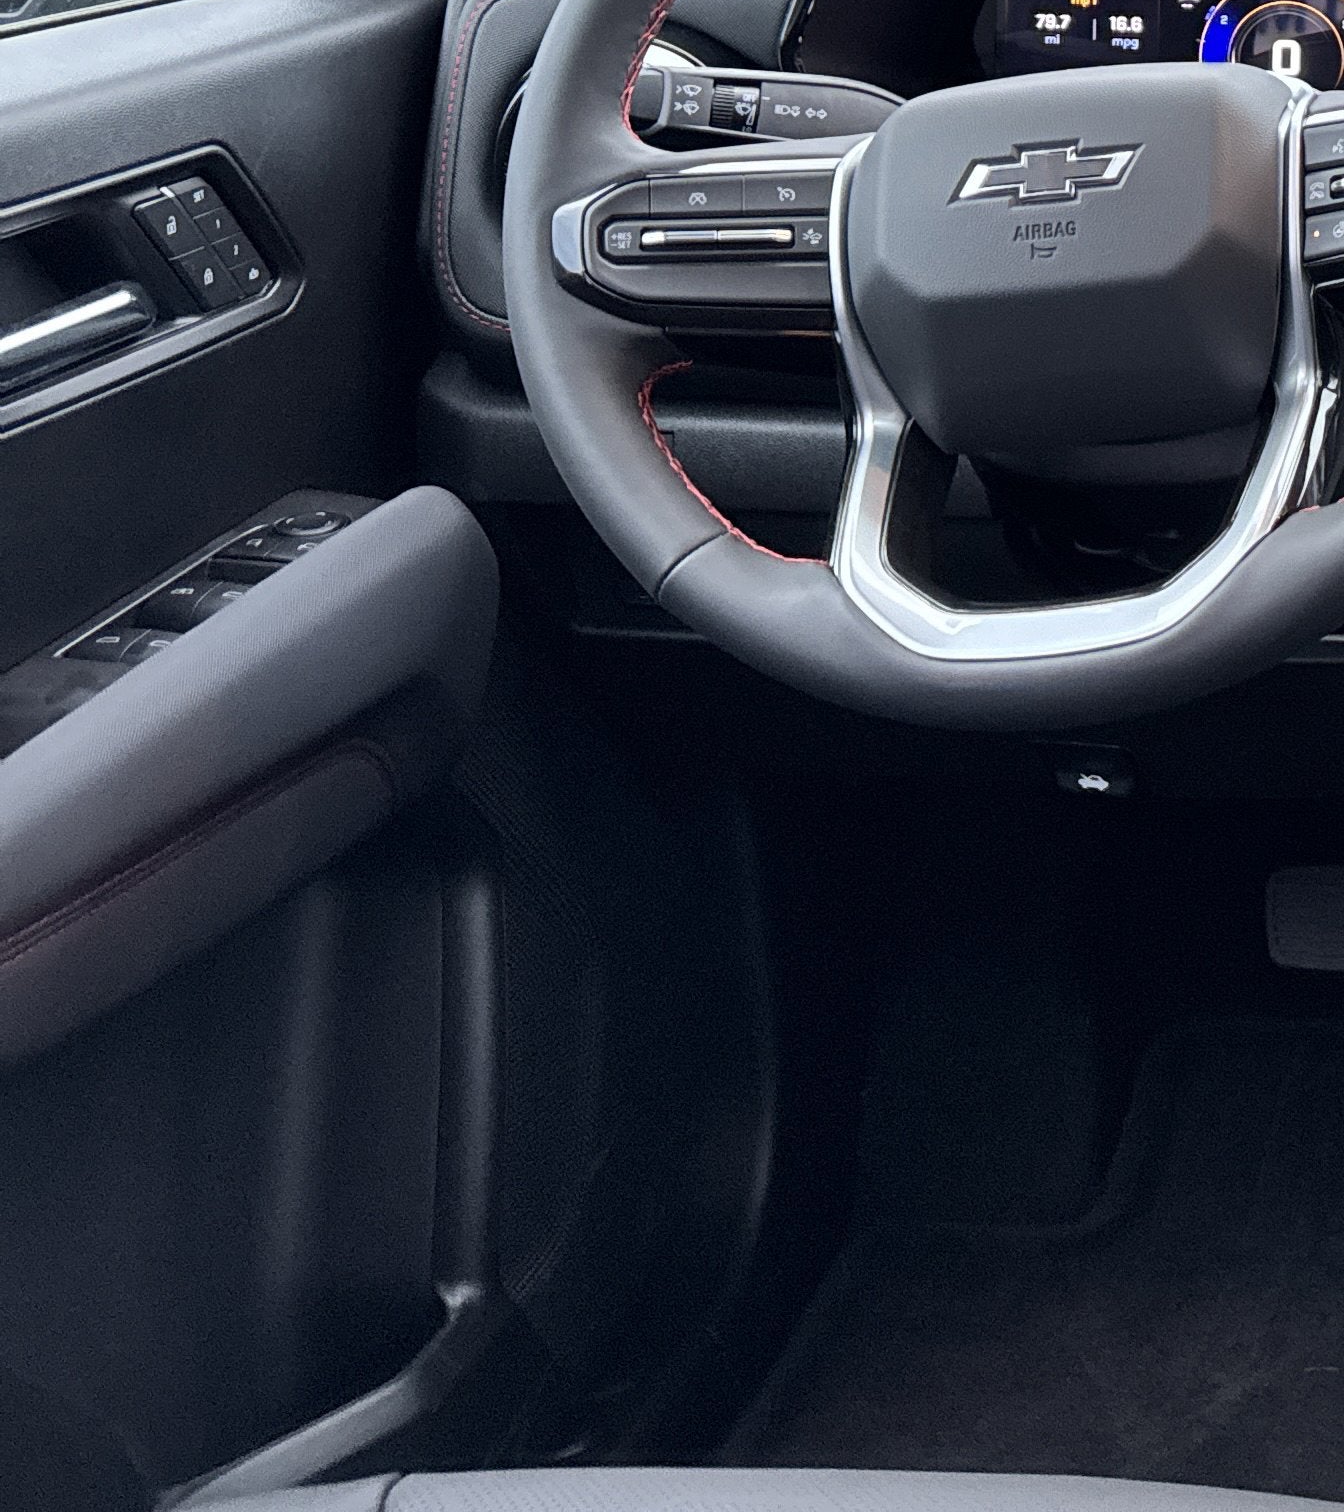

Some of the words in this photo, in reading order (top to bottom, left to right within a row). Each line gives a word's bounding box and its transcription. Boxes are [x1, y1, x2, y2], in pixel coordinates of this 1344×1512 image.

[1034, 12, 1073, 30] 79.7
[1108, 15, 1144, 34] 16.6
[1219, 14, 1229, 25] 2
[1044, 33, 1060, 45] mi
[1111, 37, 1140, 50] mpg
[1271, 38, 1302, 77] 0
[1012, 219, 1077, 242] AIRBAG
